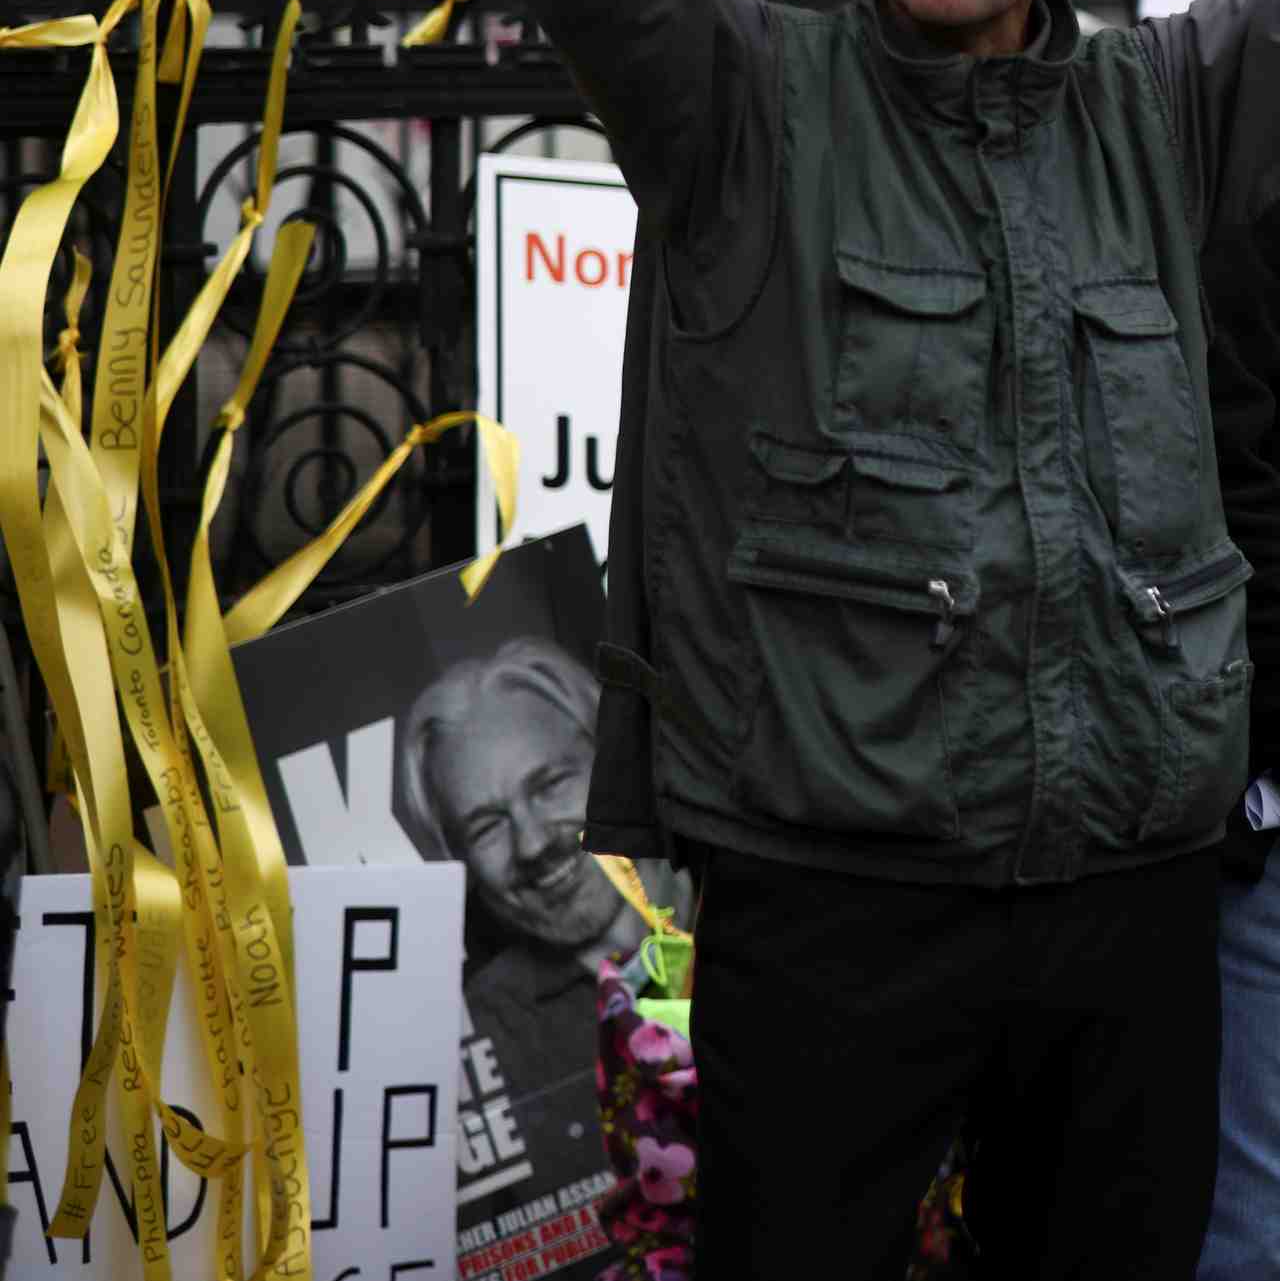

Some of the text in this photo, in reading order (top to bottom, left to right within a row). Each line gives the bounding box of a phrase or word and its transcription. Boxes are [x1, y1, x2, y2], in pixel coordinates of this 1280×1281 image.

[116, 104, 158, 308] Saunders
[99, 324, 147, 452] Benny
[241, 904, 284, 1009] Noah
